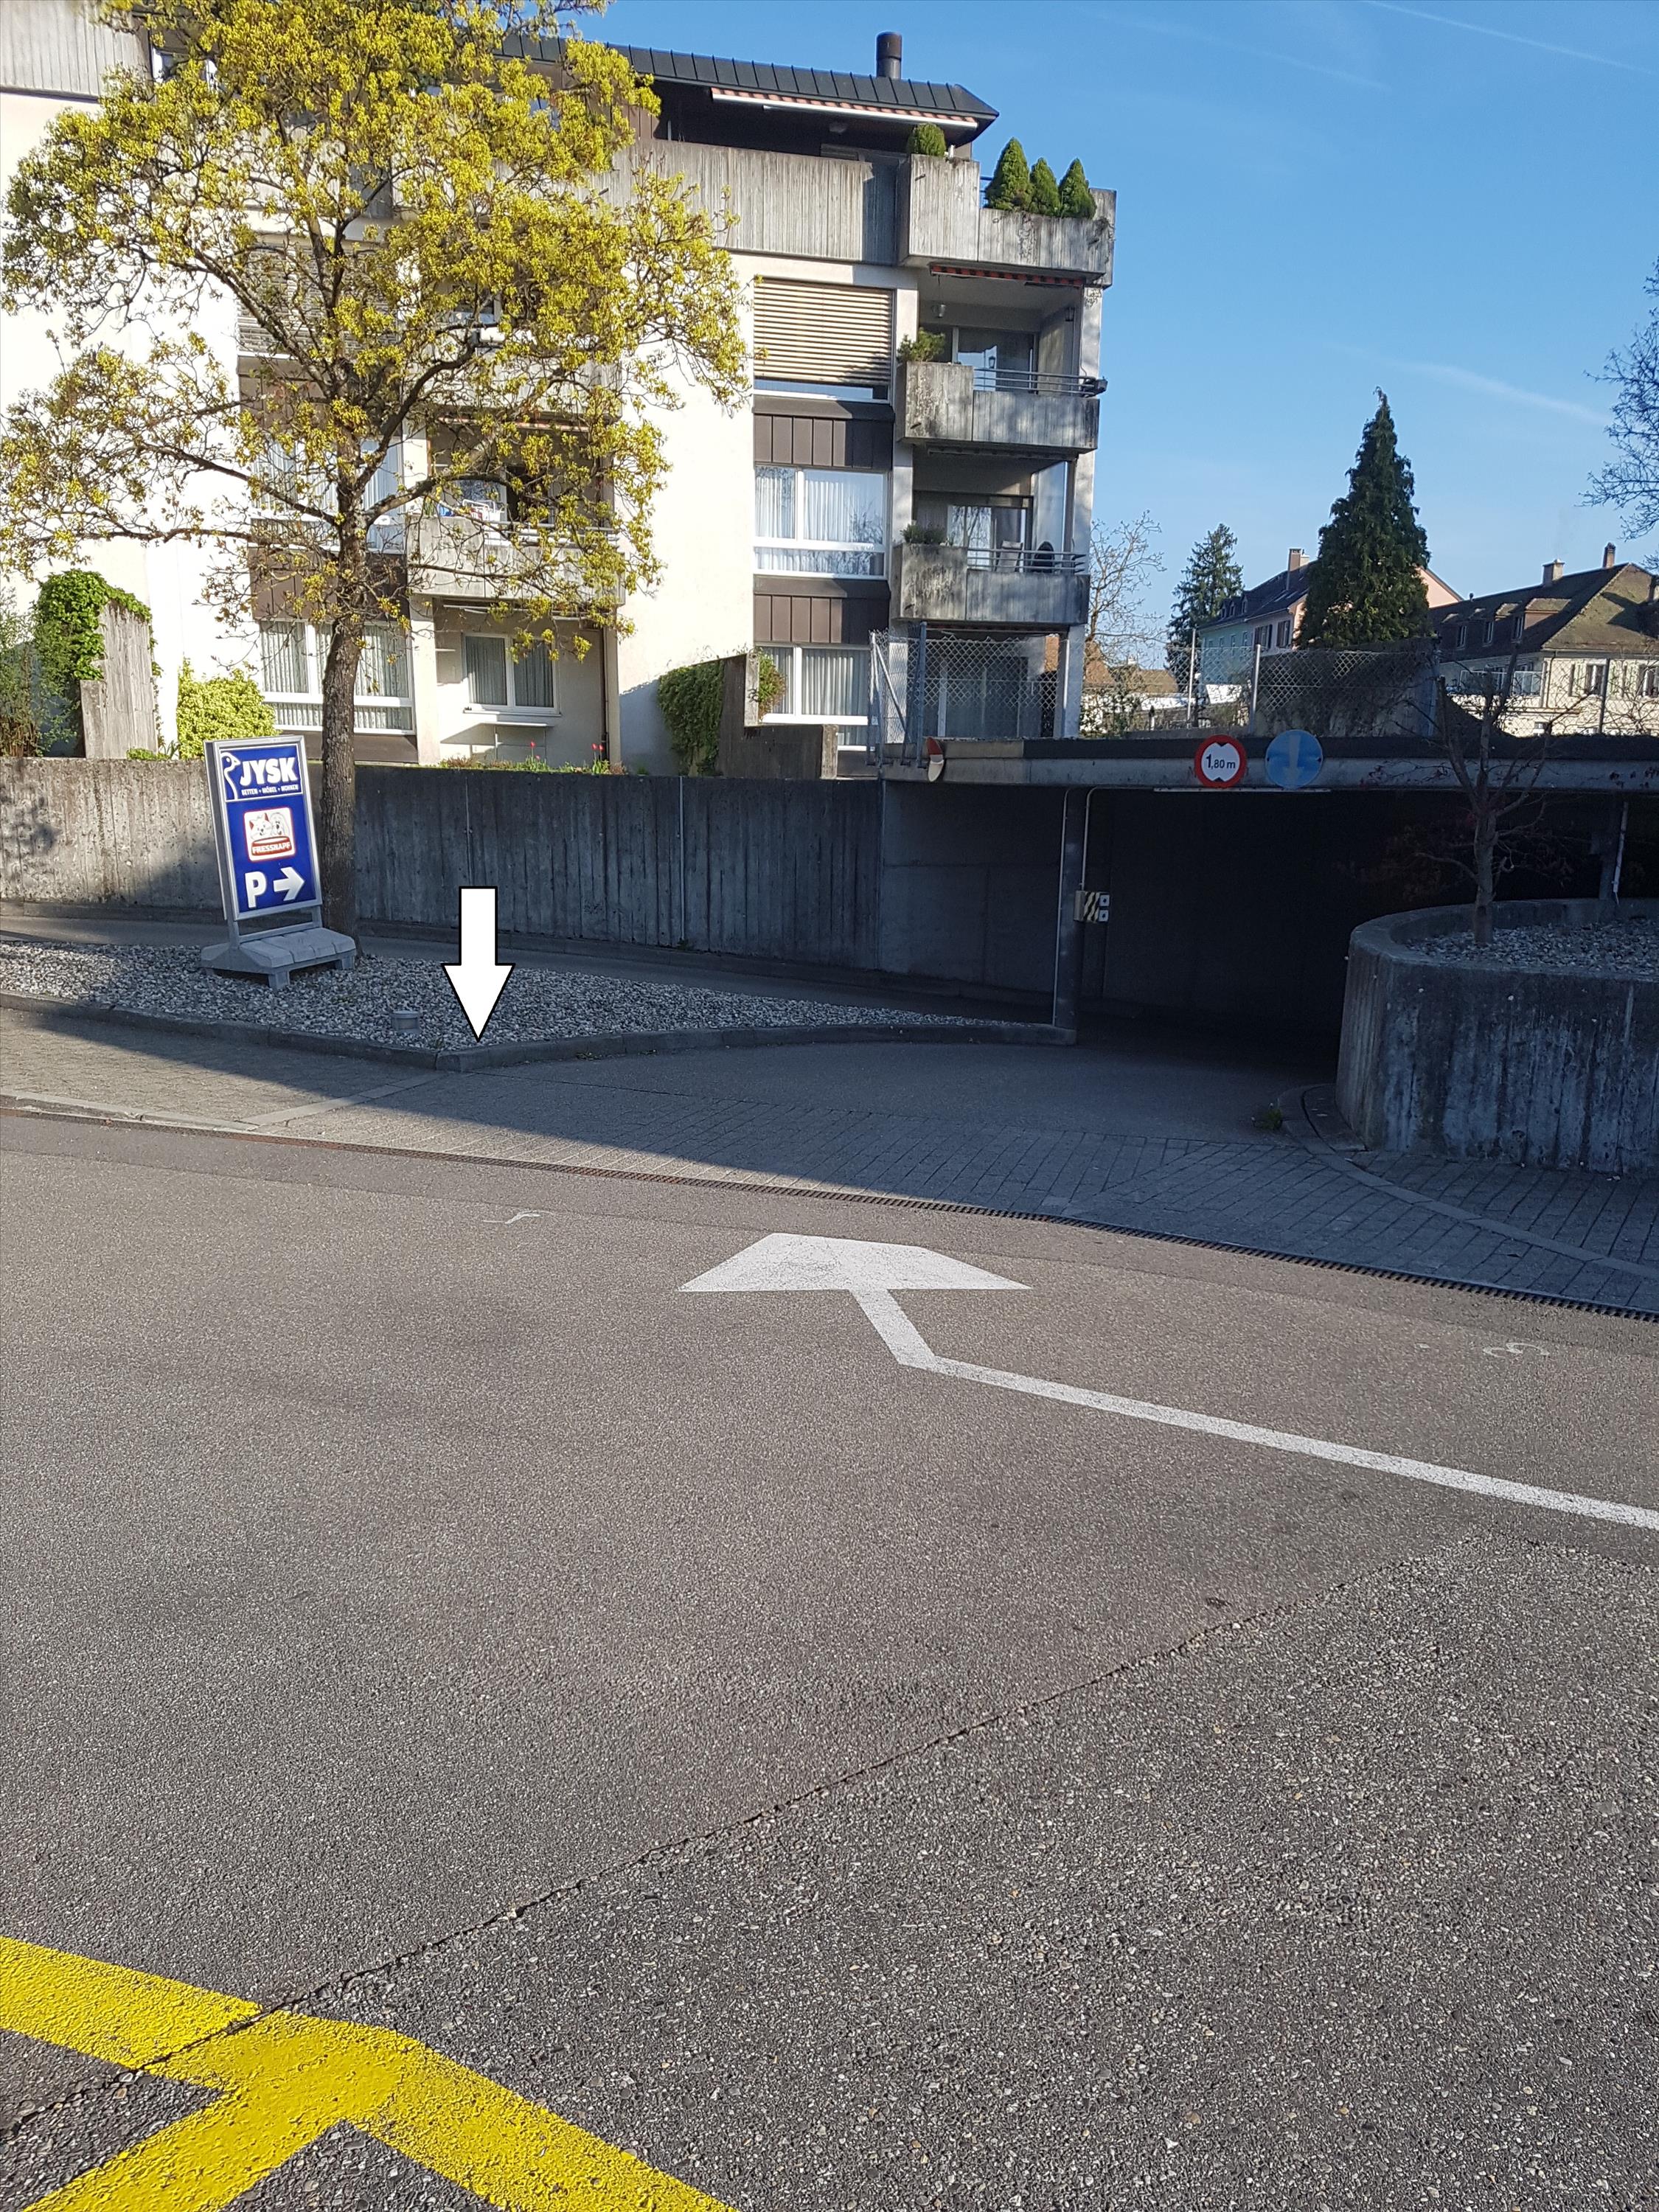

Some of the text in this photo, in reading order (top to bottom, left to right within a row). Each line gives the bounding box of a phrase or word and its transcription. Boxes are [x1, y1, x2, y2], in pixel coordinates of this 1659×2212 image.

[240, 757, 298, 786] JYSK
[1206, 754, 1236, 769] 1,80 m
[252, 841, 291, 855] FRESSNAPF
[245, 871, 267, 908] P
